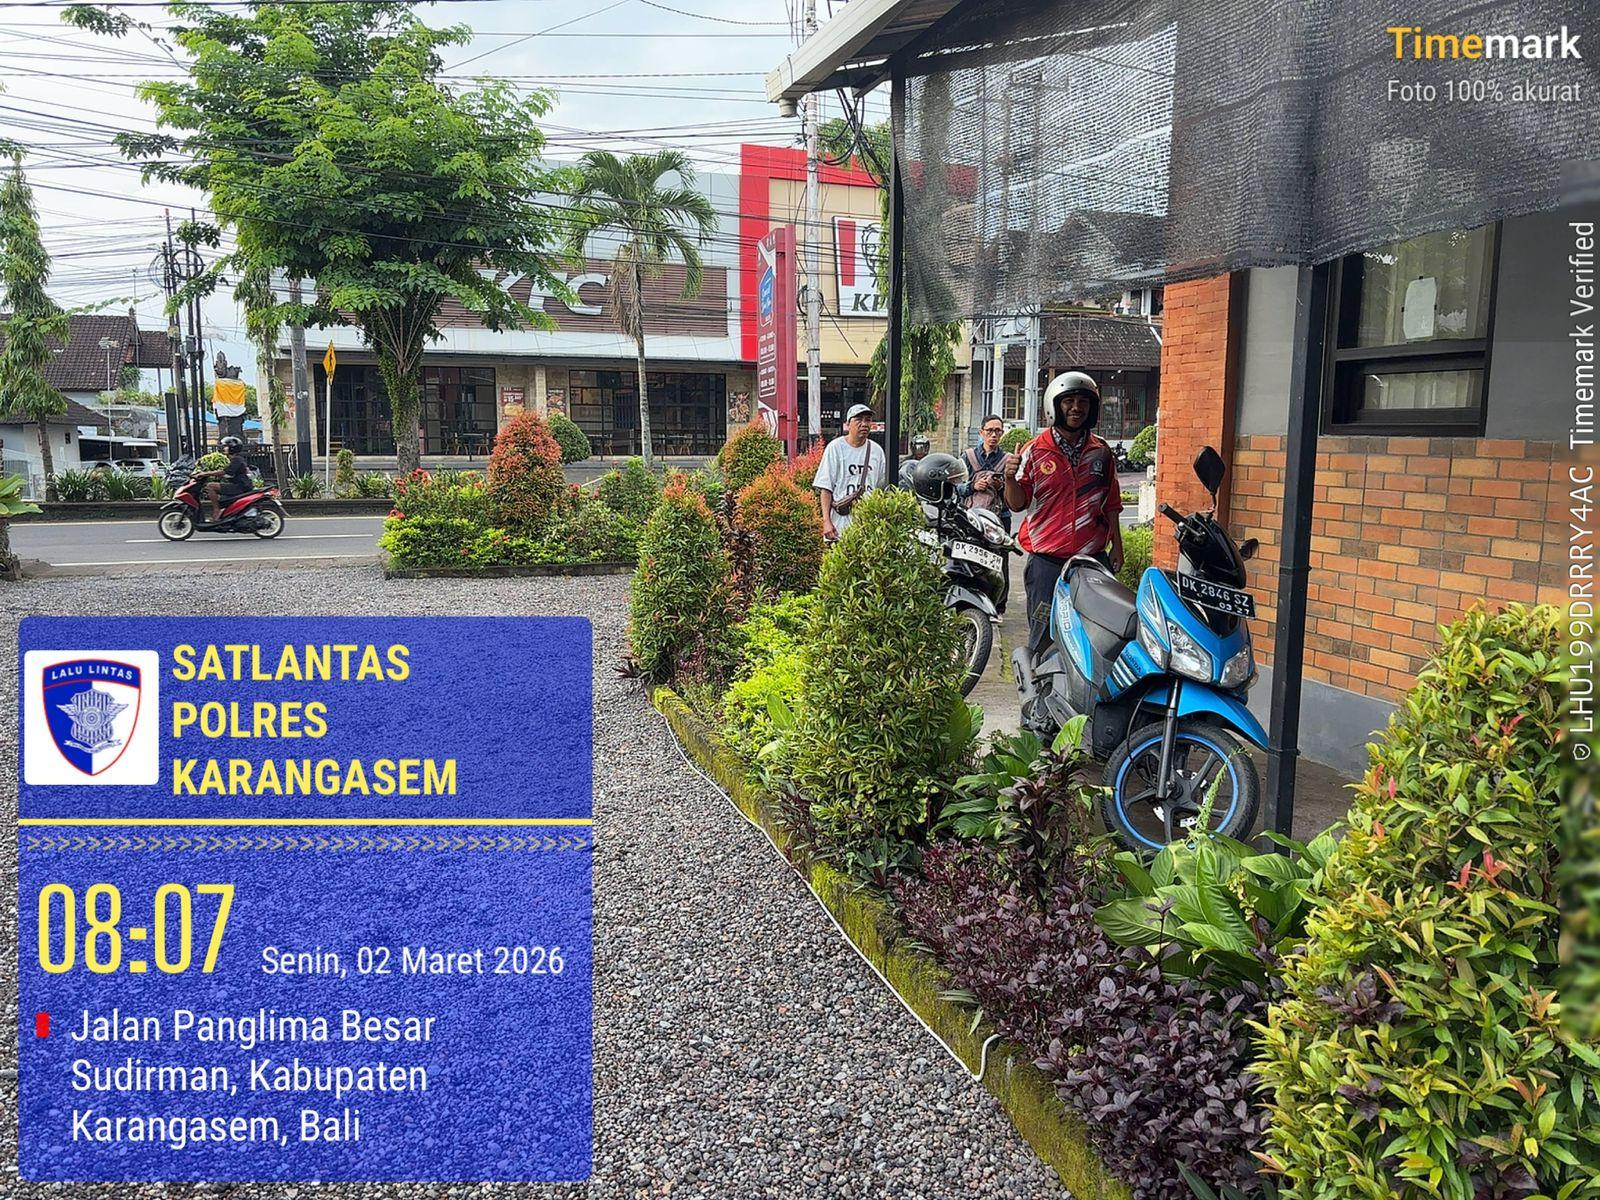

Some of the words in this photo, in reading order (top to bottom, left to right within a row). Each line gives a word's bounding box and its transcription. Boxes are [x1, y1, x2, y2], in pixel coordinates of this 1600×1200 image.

[1182, 576, 1197, 592] DK
[1200, 583, 1231, 601] 2846
[1234, 594, 1250, 607] SZ
[1219, 602, 1233, 611] 03
